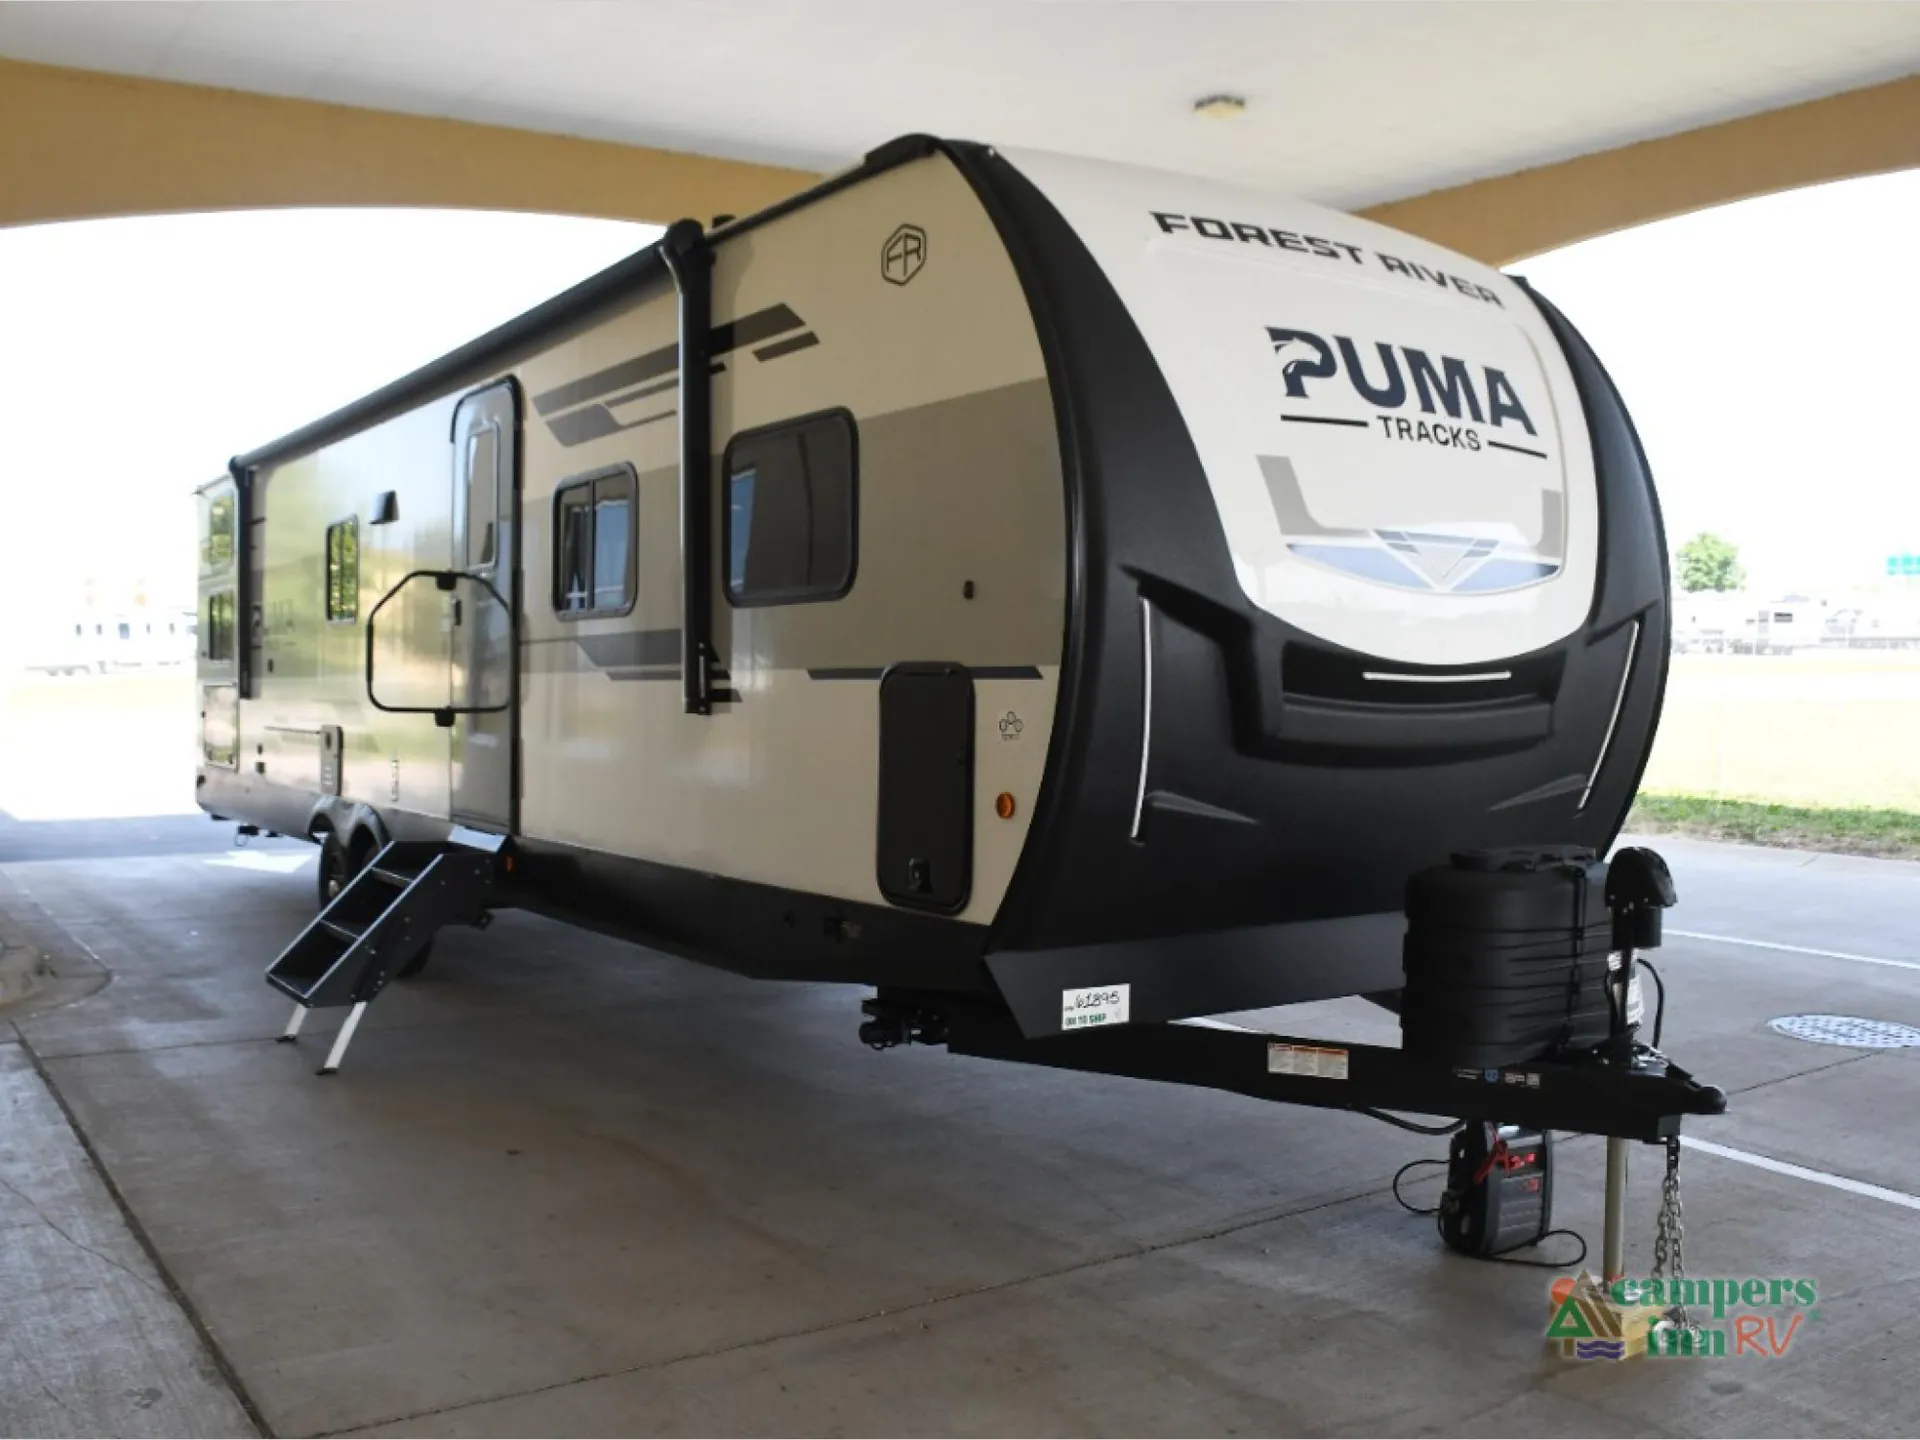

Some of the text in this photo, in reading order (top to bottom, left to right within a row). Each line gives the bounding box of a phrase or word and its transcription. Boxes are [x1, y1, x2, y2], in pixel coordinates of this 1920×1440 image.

[1148, 210, 1505, 310] FOREST RIVER
[1265, 326, 1538, 436] PUMA
[1377, 414, 1482, 452] TRACKS
